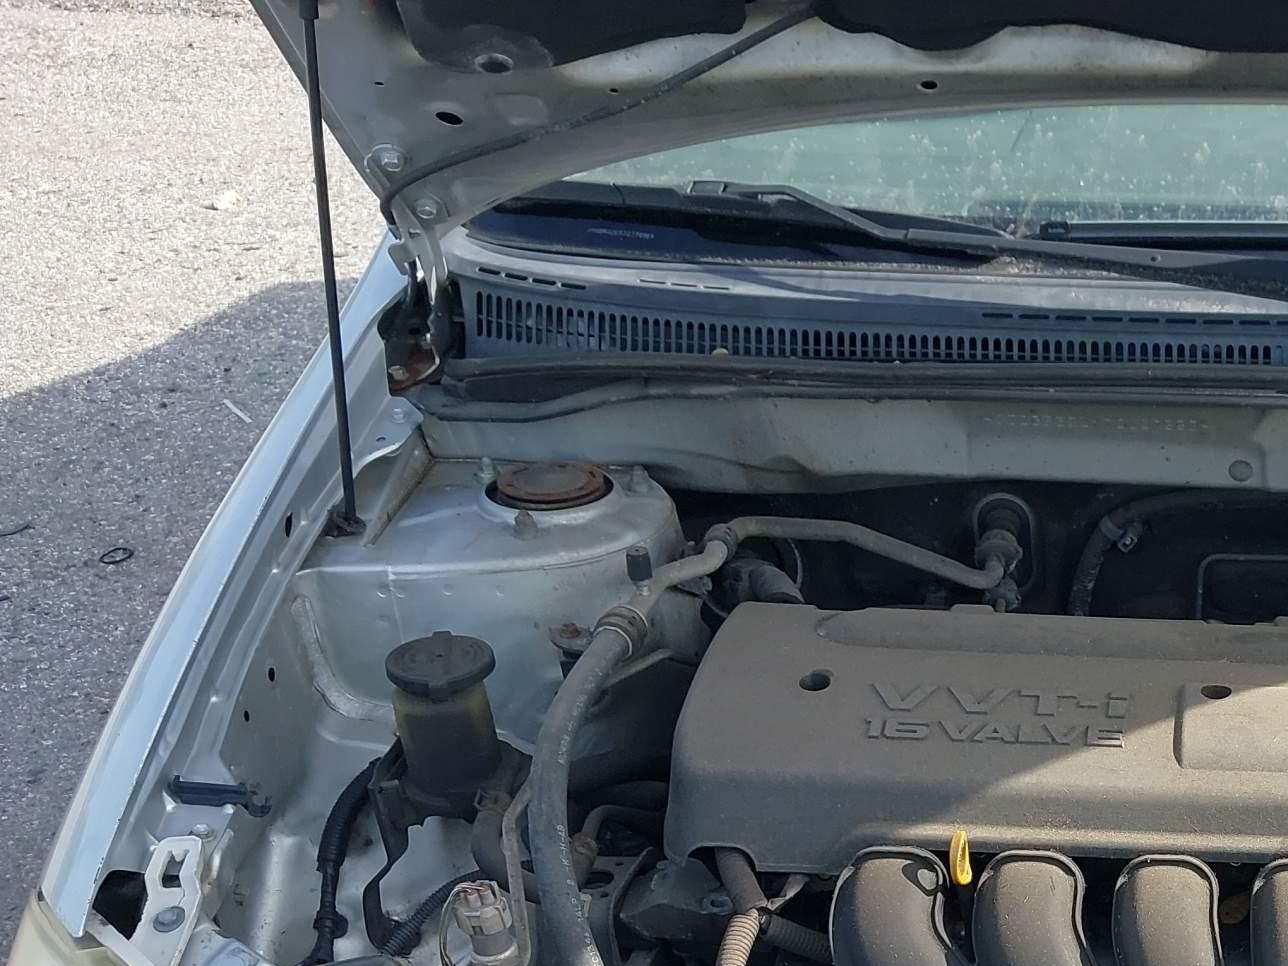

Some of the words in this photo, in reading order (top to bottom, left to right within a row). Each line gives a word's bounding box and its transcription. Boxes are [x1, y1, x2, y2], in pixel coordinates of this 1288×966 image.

[869, 681, 1129, 719] VVT-i
[864, 716, 929, 741] 16
[936, 718, 1124, 748] VALVE
